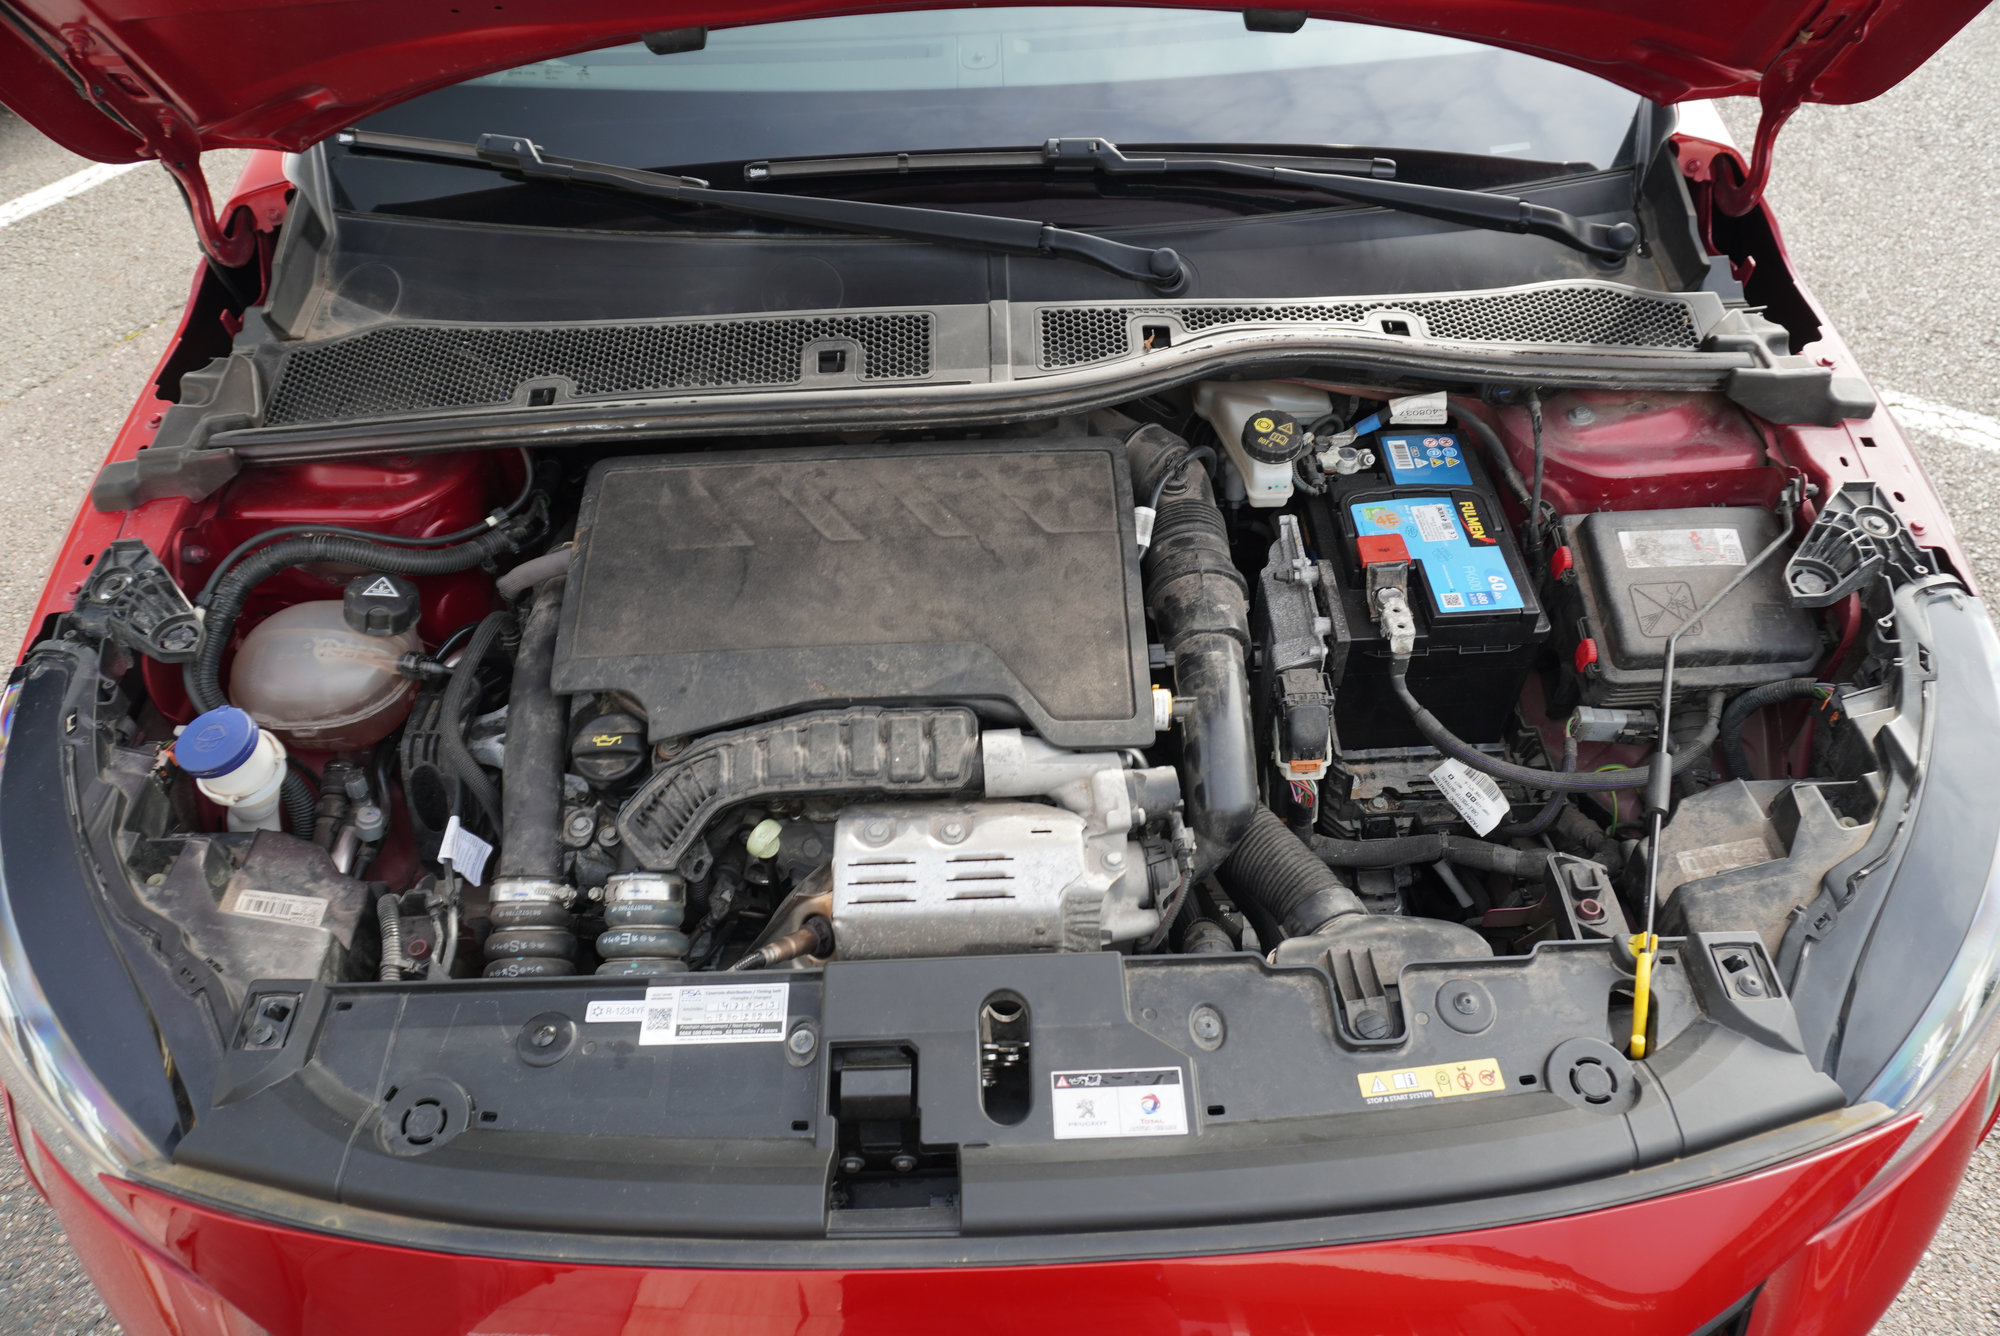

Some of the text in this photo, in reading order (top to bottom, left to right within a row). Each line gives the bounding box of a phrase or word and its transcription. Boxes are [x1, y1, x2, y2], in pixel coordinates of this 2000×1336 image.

[1459, 501, 1487, 539] FULMEN
[1487, 575, 1508, 591] 60
[1476, 592, 1489, 605] 680
[682, 989, 702, 997] PSA
[1366, 1096, 1383, 1105] STOP
[1389, 1094, 1408, 1102] START
[1409, 1091, 1433, 1100] SYSTEM
